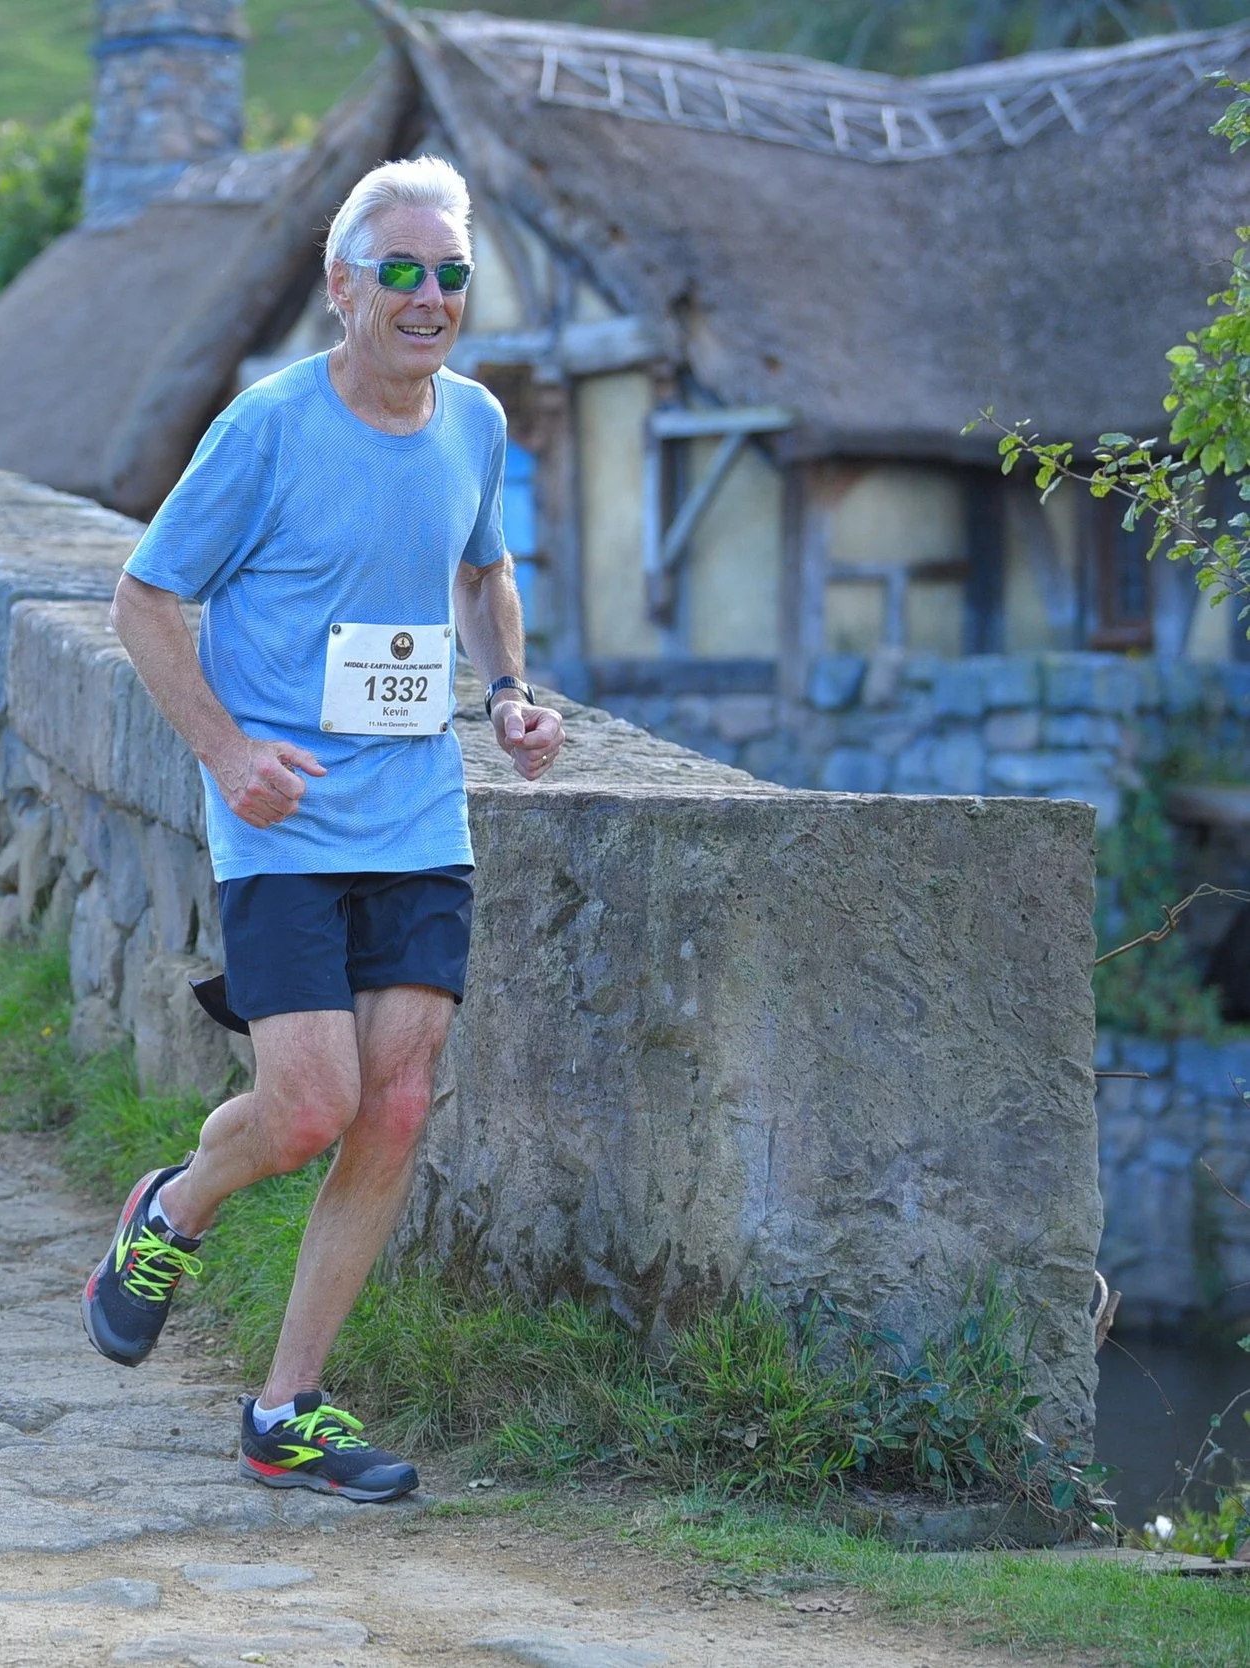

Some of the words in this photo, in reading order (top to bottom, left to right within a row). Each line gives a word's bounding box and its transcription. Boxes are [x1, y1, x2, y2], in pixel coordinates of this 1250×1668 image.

[344, 661, 391, 670] MIDDLE-EARTH
[364, 675, 428, 702] 1332
[382, 706, 409, 716] Kevin
